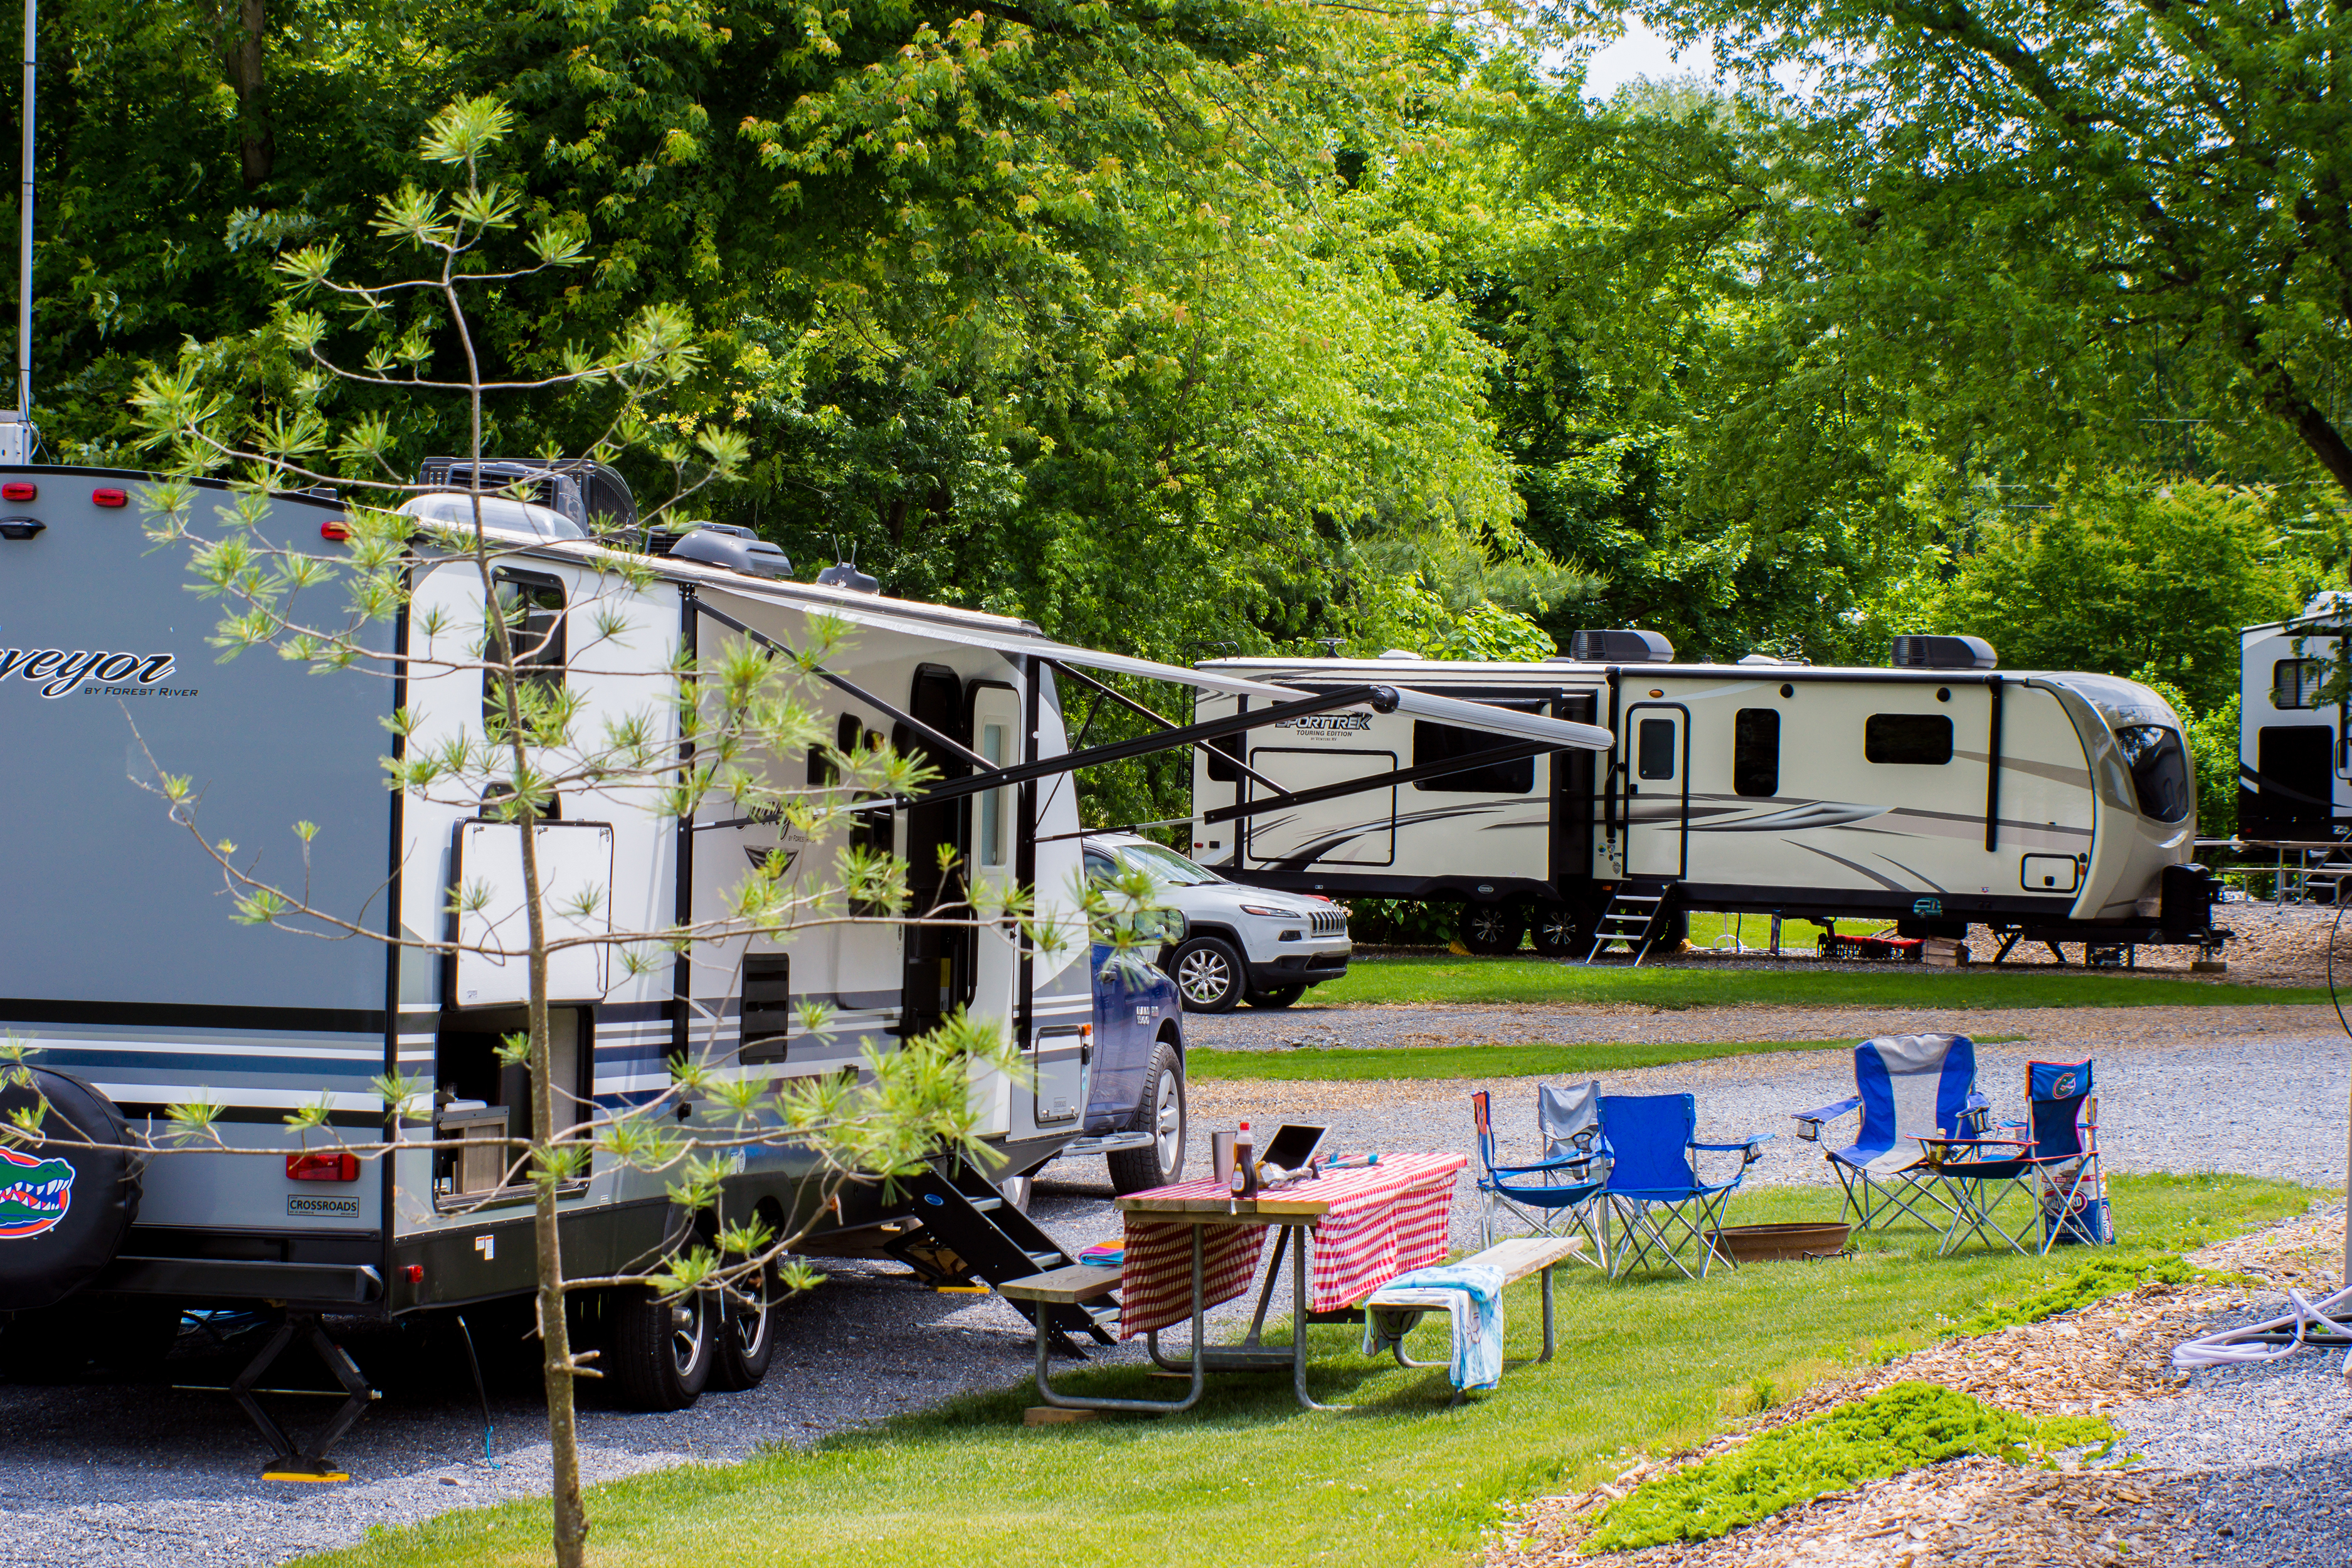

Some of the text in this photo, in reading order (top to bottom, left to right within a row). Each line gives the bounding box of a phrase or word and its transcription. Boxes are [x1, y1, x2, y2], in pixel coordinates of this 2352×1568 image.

[0, 649, 177, 699] veyor
[105, 687, 156, 696] FOREST
[159, 687, 199, 696] RIVER
[793, 835, 806, 843] FORES
[290, 1199, 357, 1212] CROSSROADS
[2102, 1208, 2111, 1239] KINGSFORD
